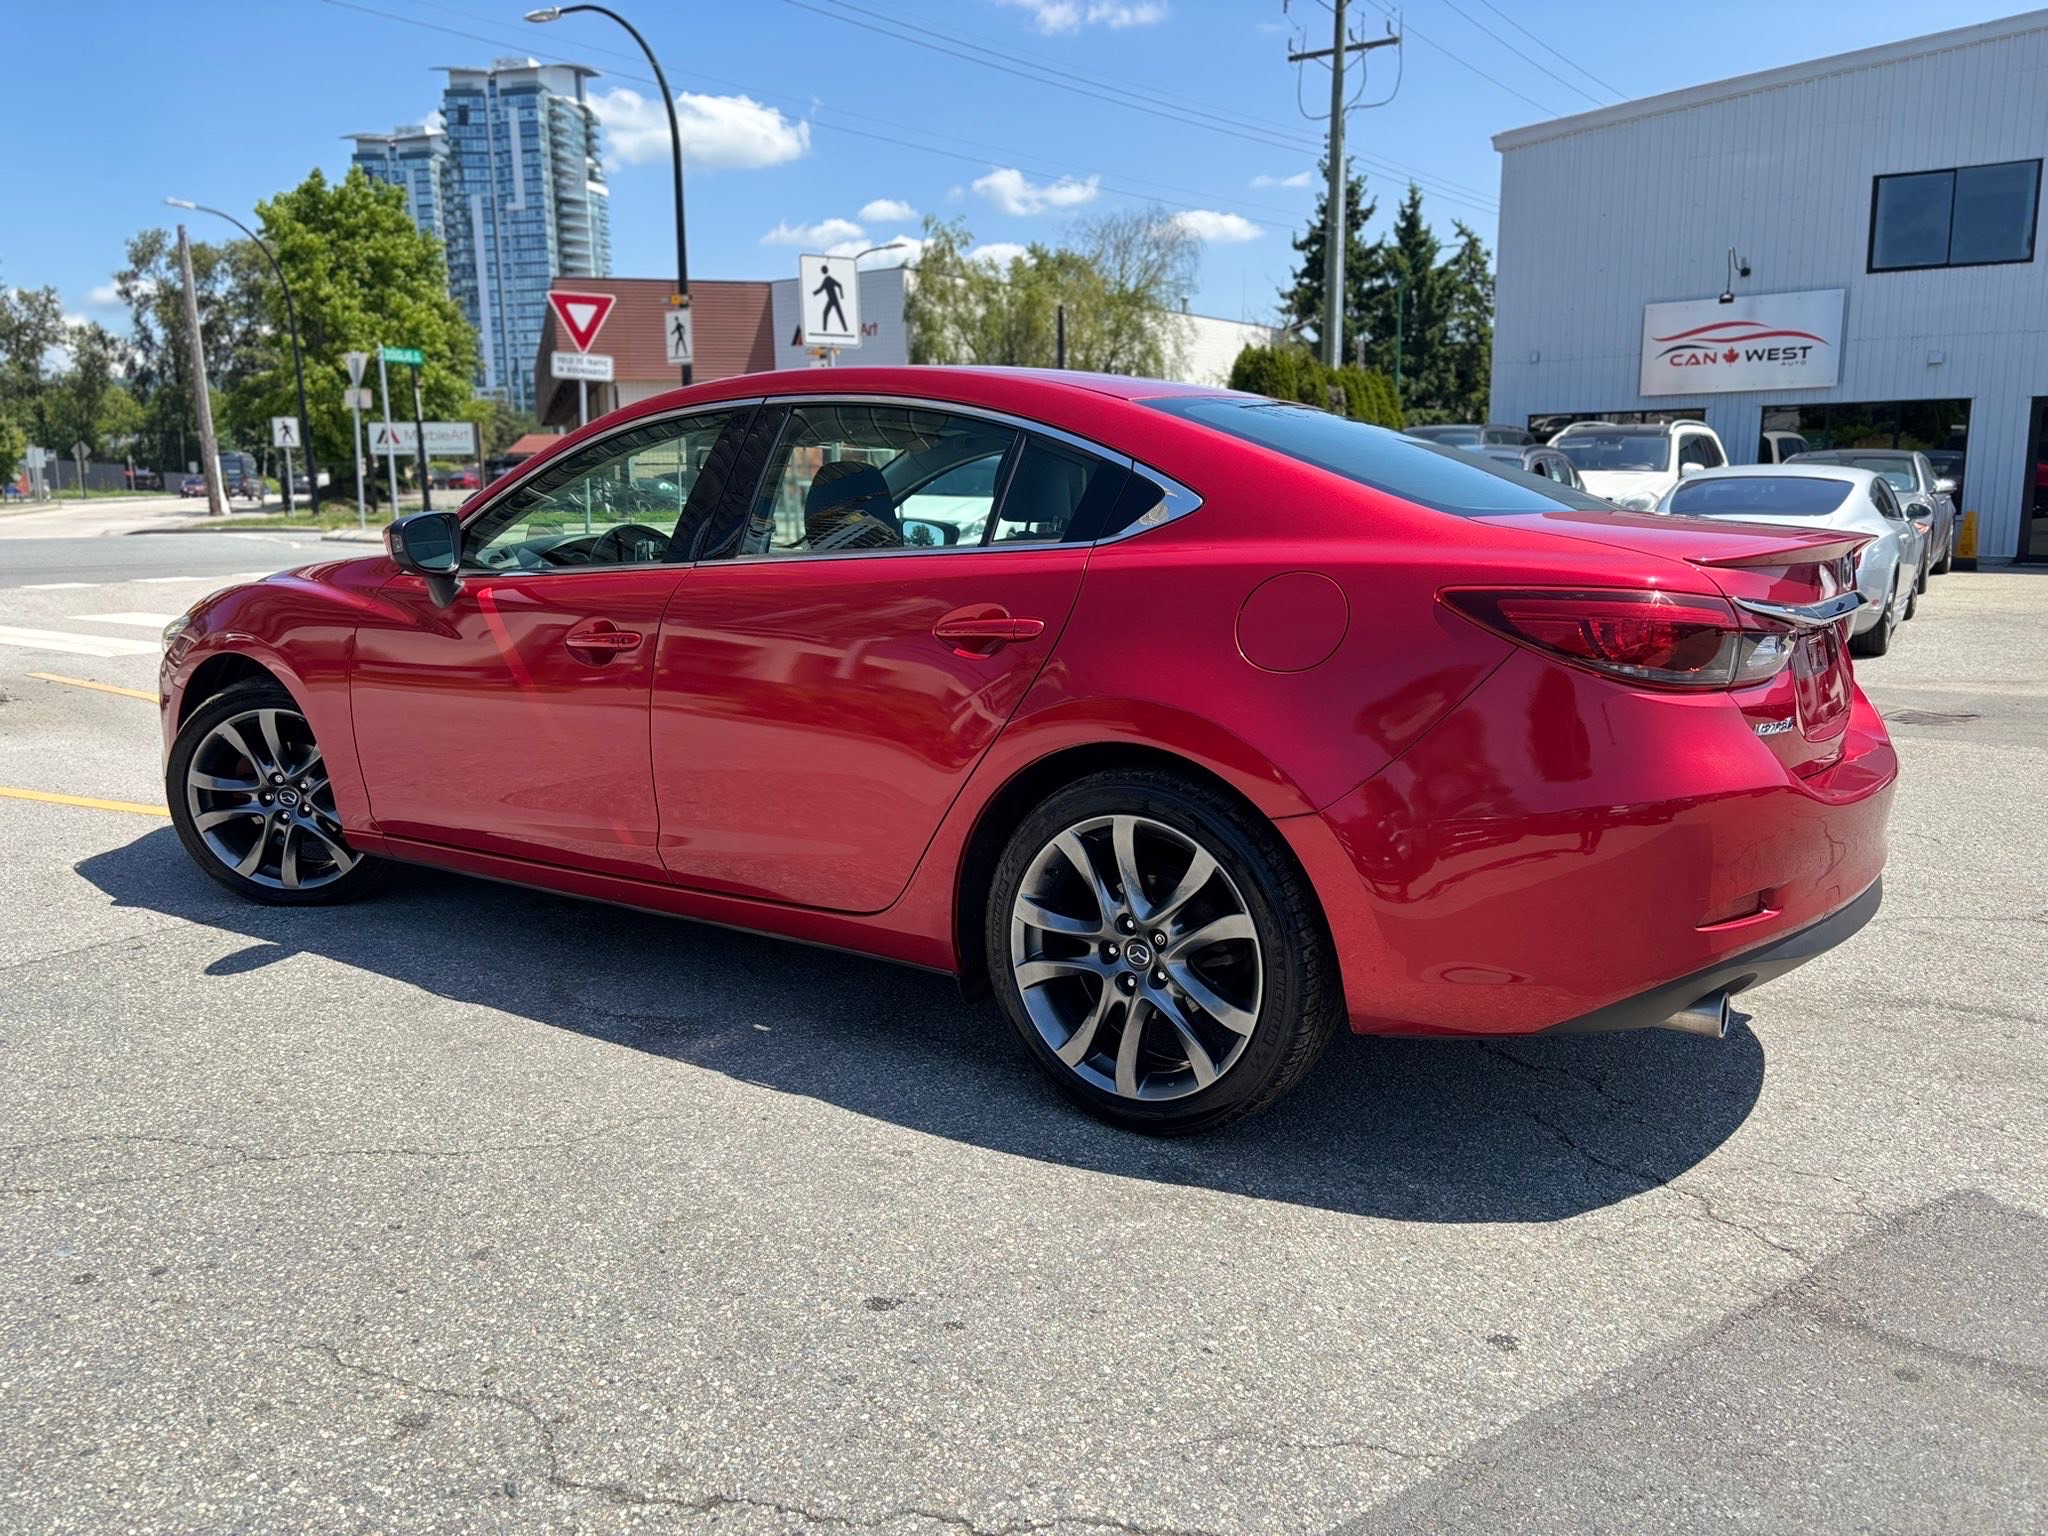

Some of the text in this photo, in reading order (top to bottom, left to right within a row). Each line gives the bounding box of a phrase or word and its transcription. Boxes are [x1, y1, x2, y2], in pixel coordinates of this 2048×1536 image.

[1669, 345, 1813, 367] CAN WEST
[404, 429, 469, 441] MrbleArt
